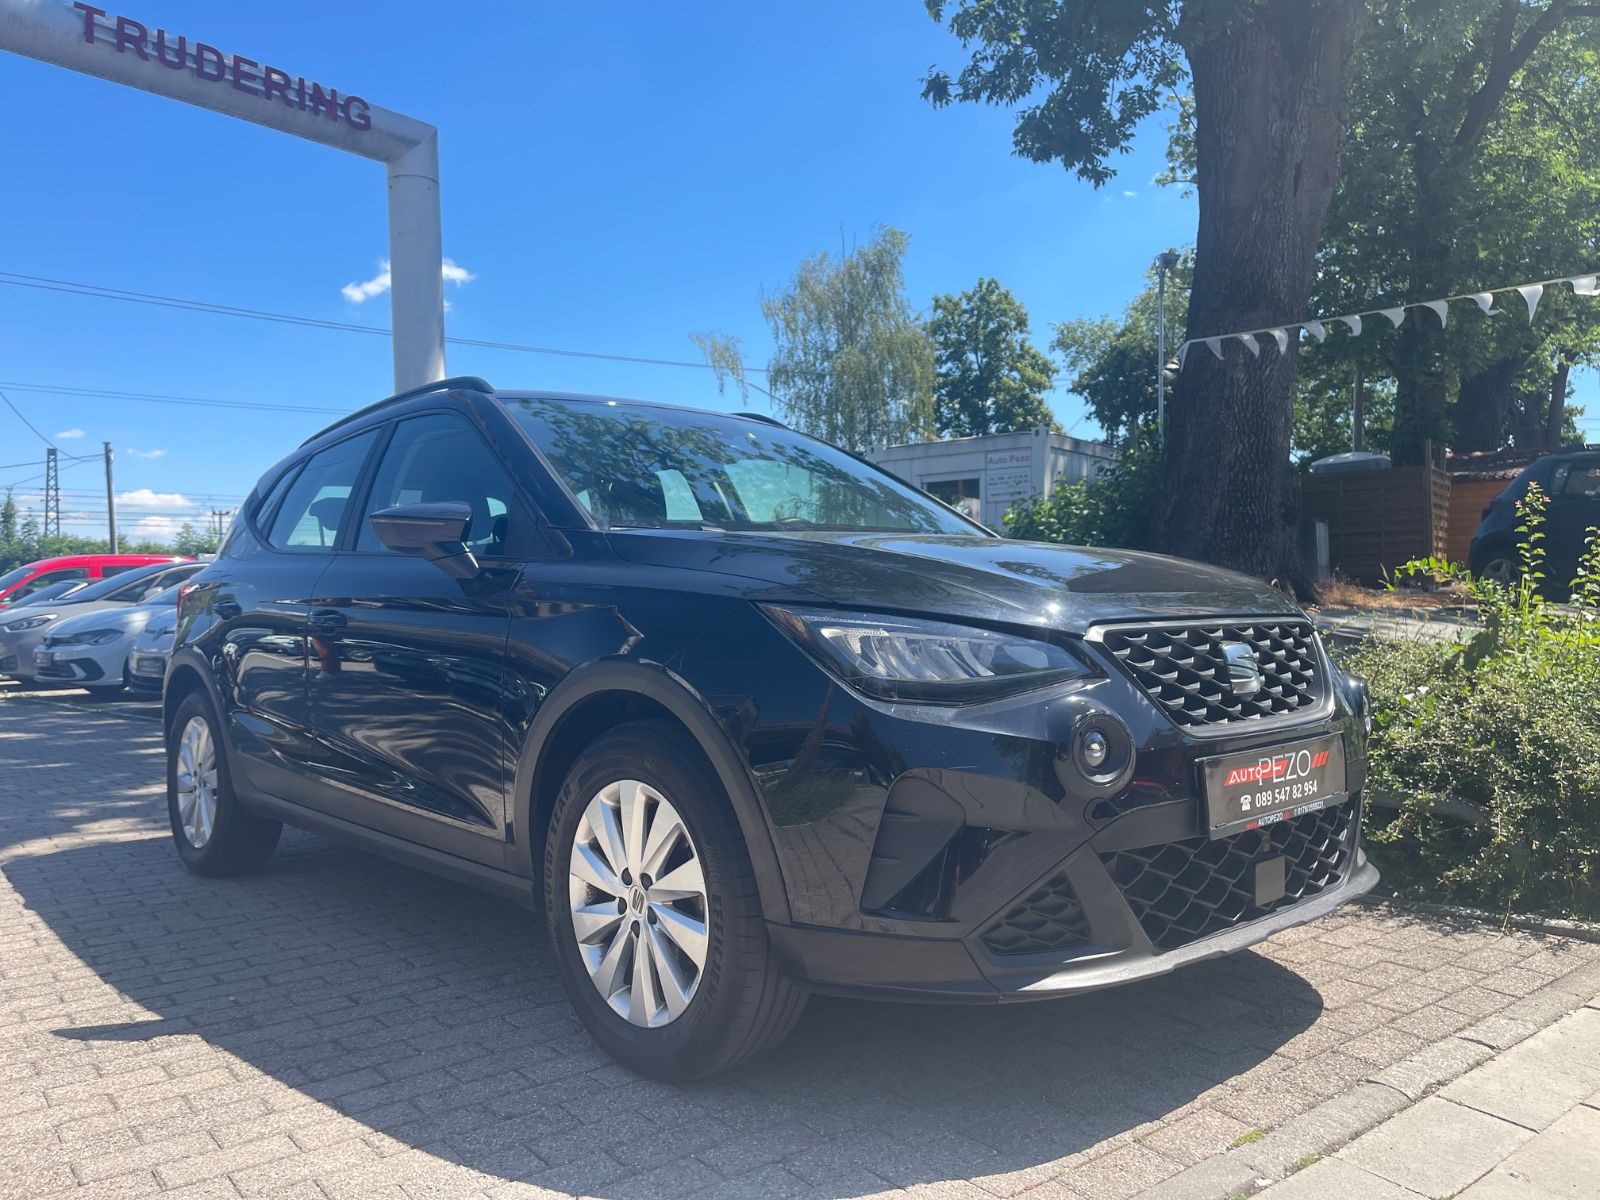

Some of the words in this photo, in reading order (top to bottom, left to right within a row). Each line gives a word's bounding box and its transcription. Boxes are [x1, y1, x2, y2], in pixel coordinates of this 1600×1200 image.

[74, 1, 371, 131] TRUDERING
[988, 457, 1007, 465] Auto
[1010, 455, 1031, 463] Pezo
[1255, 790, 1272, 808] 089
[1275, 786, 1290, 803] 547
[1292, 784, 1302, 799] 82
[1304, 779, 1318, 796] 954
